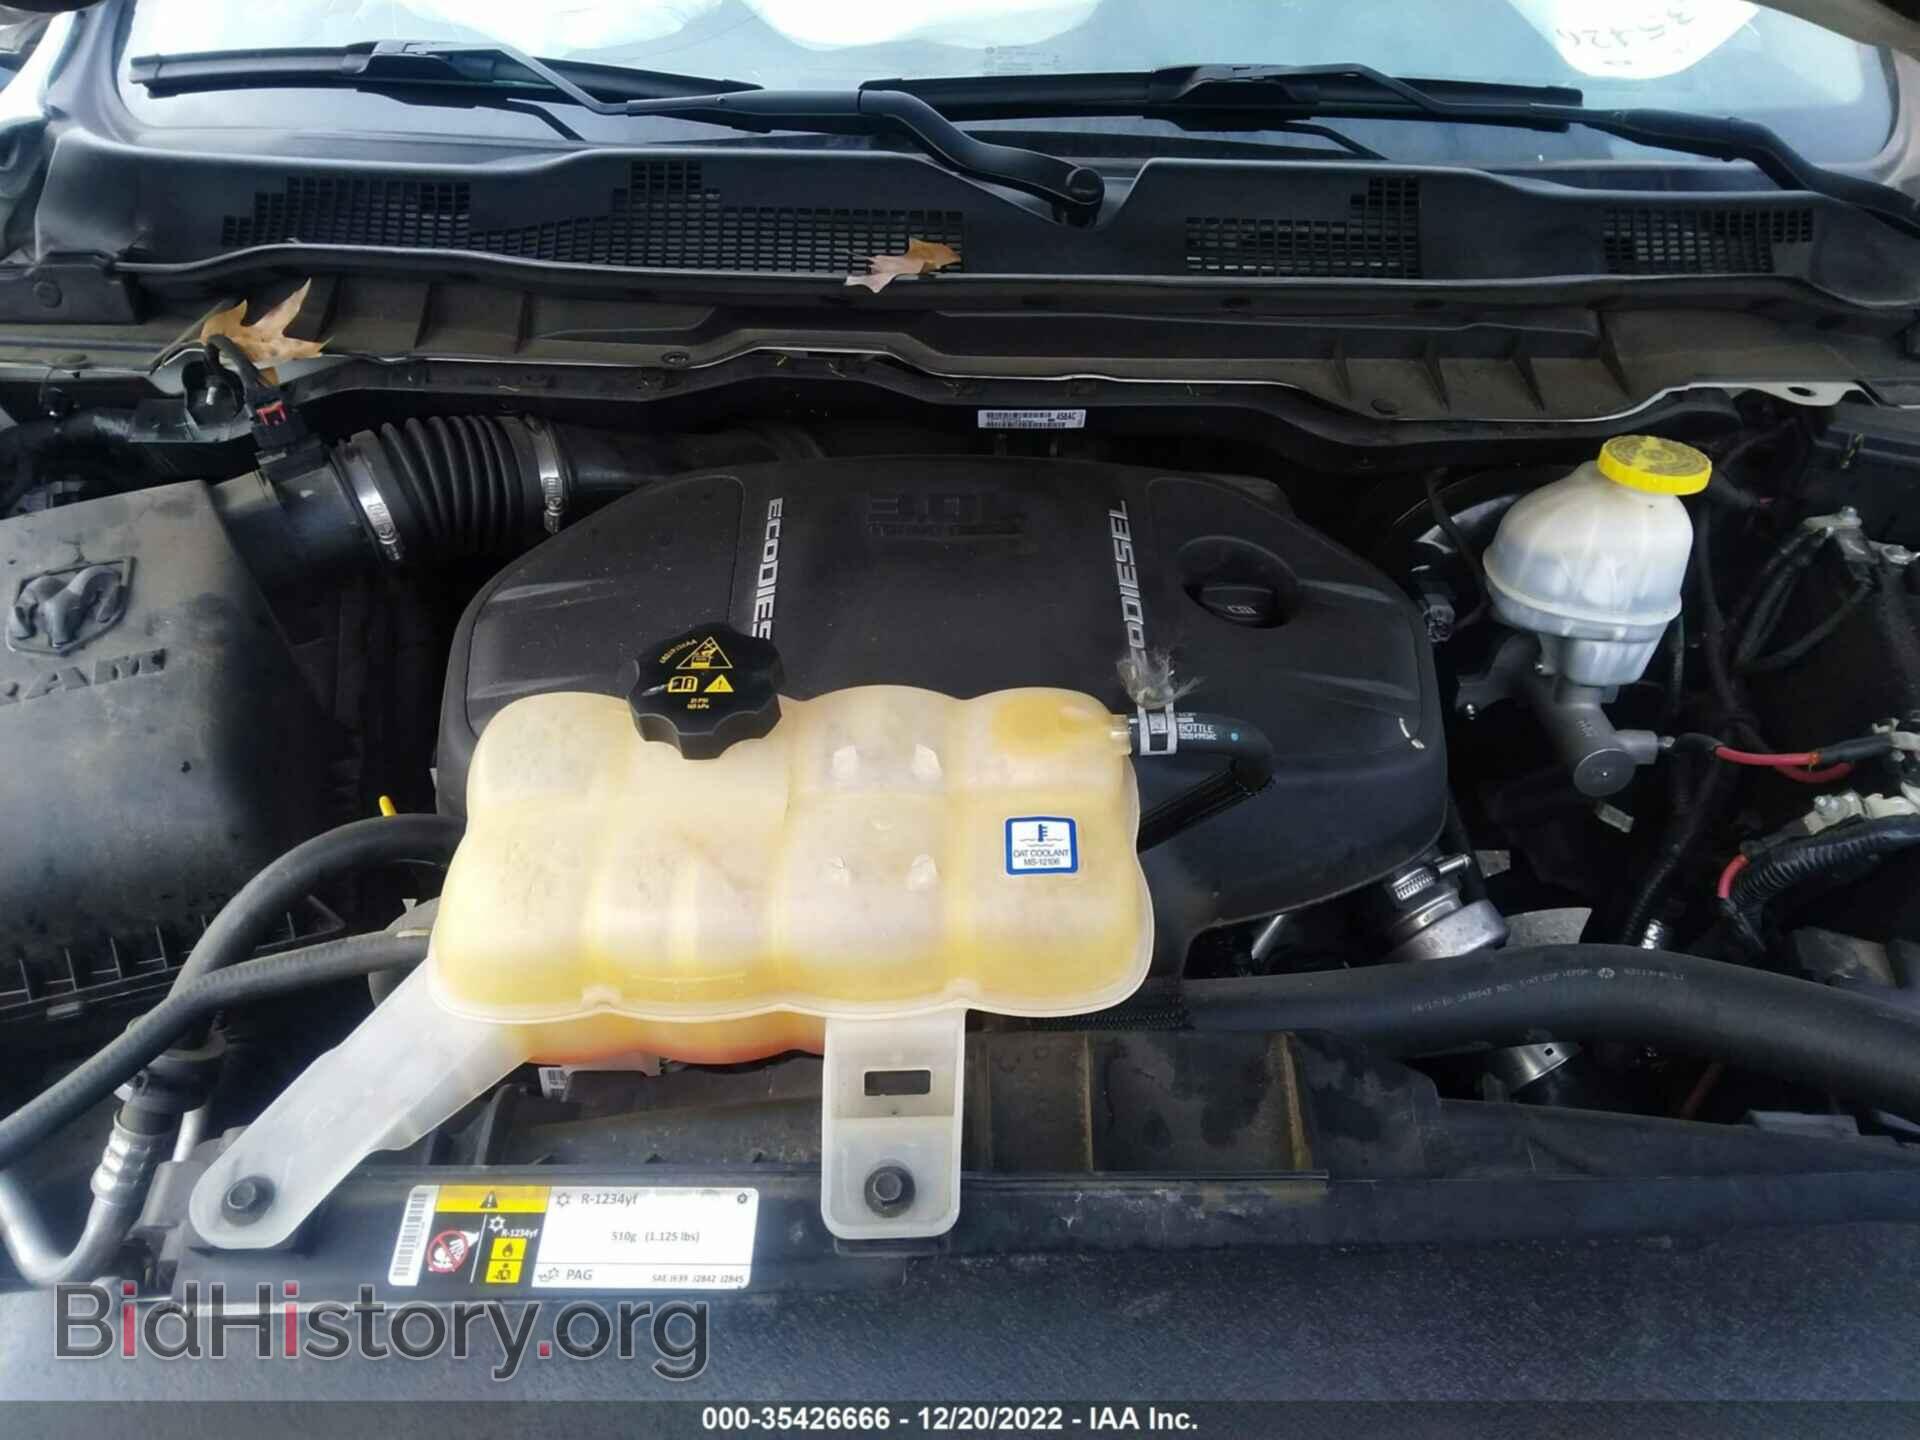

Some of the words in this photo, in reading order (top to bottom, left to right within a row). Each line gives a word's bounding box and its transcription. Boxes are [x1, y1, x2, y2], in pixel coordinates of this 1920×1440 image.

[752, 497, 784, 640] ECODIES
[1030, 848, 1069, 857] COOLANT
[580, 1192, 639, 1208] R-1234yf
[610, 1231, 637, 1244] 510g
[644, 1231, 679, 1243] (1.125
[680, 1231, 700, 1243] lbs)
[566, 1269, 593, 1281] PAG
